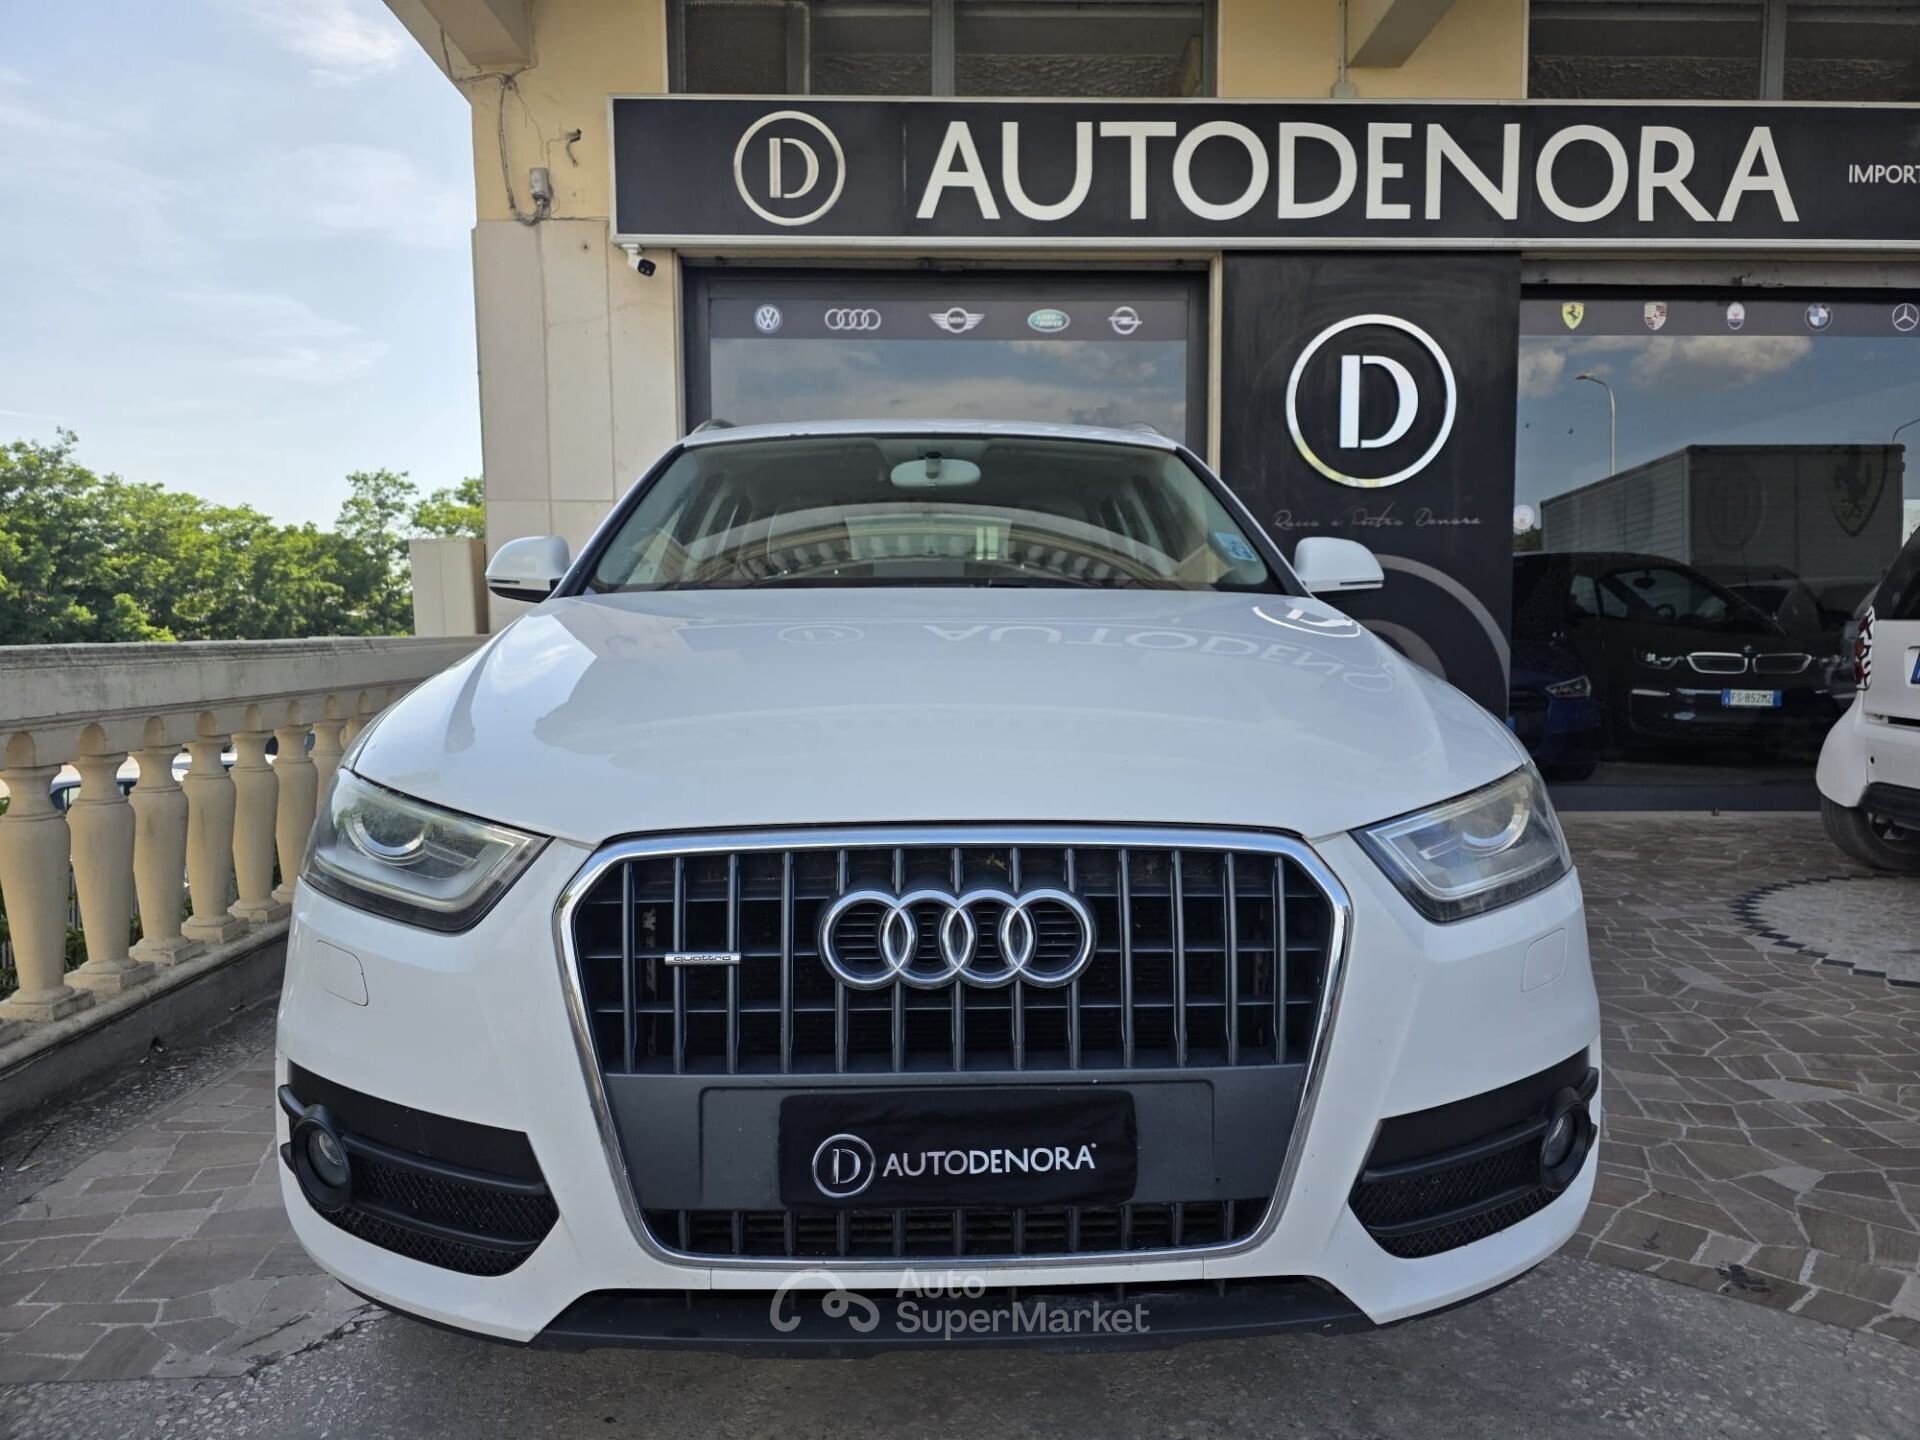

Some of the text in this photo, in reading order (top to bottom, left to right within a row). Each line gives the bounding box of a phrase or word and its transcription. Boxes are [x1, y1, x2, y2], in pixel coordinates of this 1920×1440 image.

[915, 120, 1800, 224] AUTODENORA
[1339, 354, 1419, 449] D
[673, 954, 732, 965] quattro
[882, 1144, 1097, 1177] AUTODENORA
